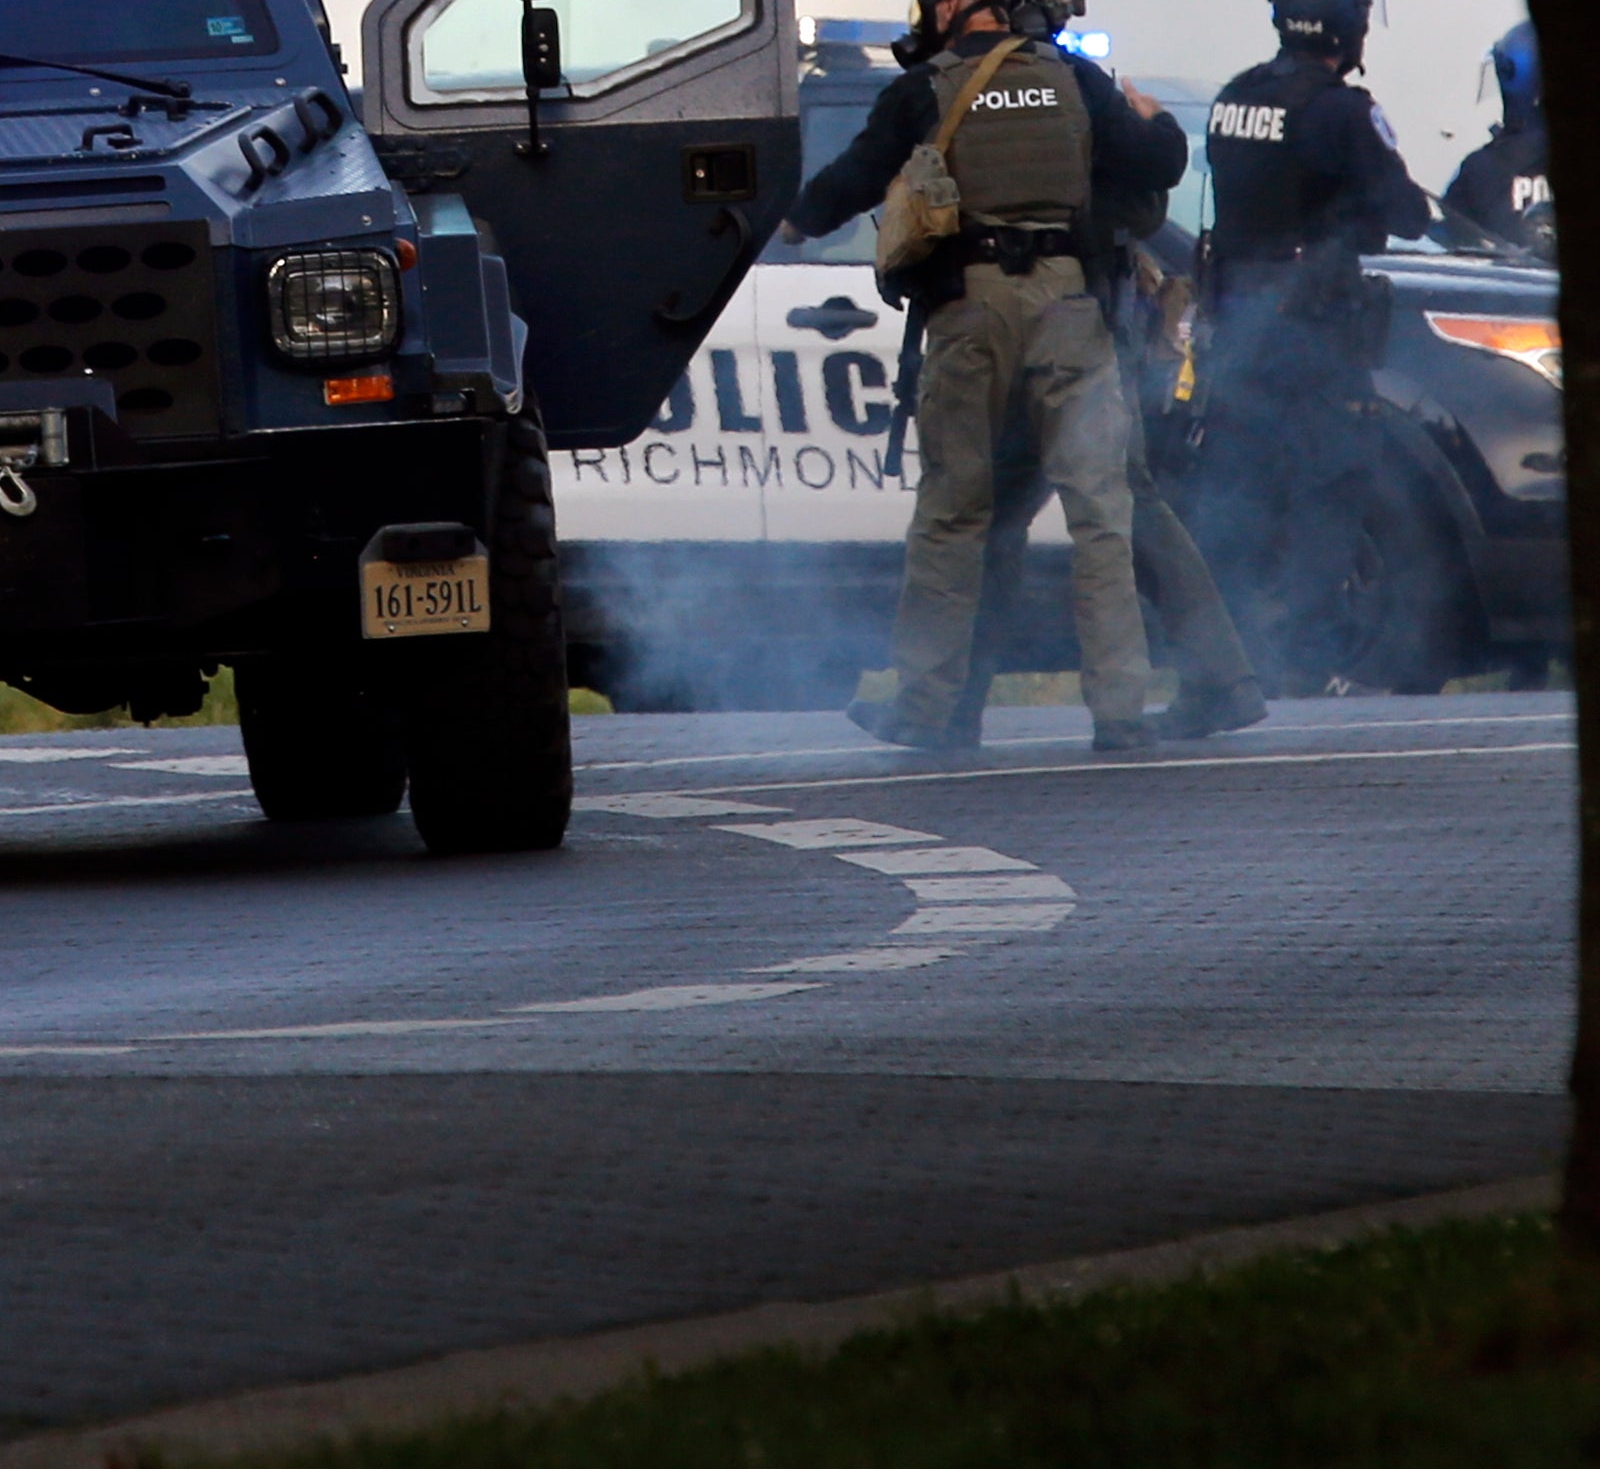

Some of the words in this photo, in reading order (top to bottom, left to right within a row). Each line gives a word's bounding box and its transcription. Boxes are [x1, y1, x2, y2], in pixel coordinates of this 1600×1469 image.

[971, 88, 1058, 111] POLICE
[1209, 102, 1287, 141] POLICE
[375, 579, 482, 618] 161-591L
